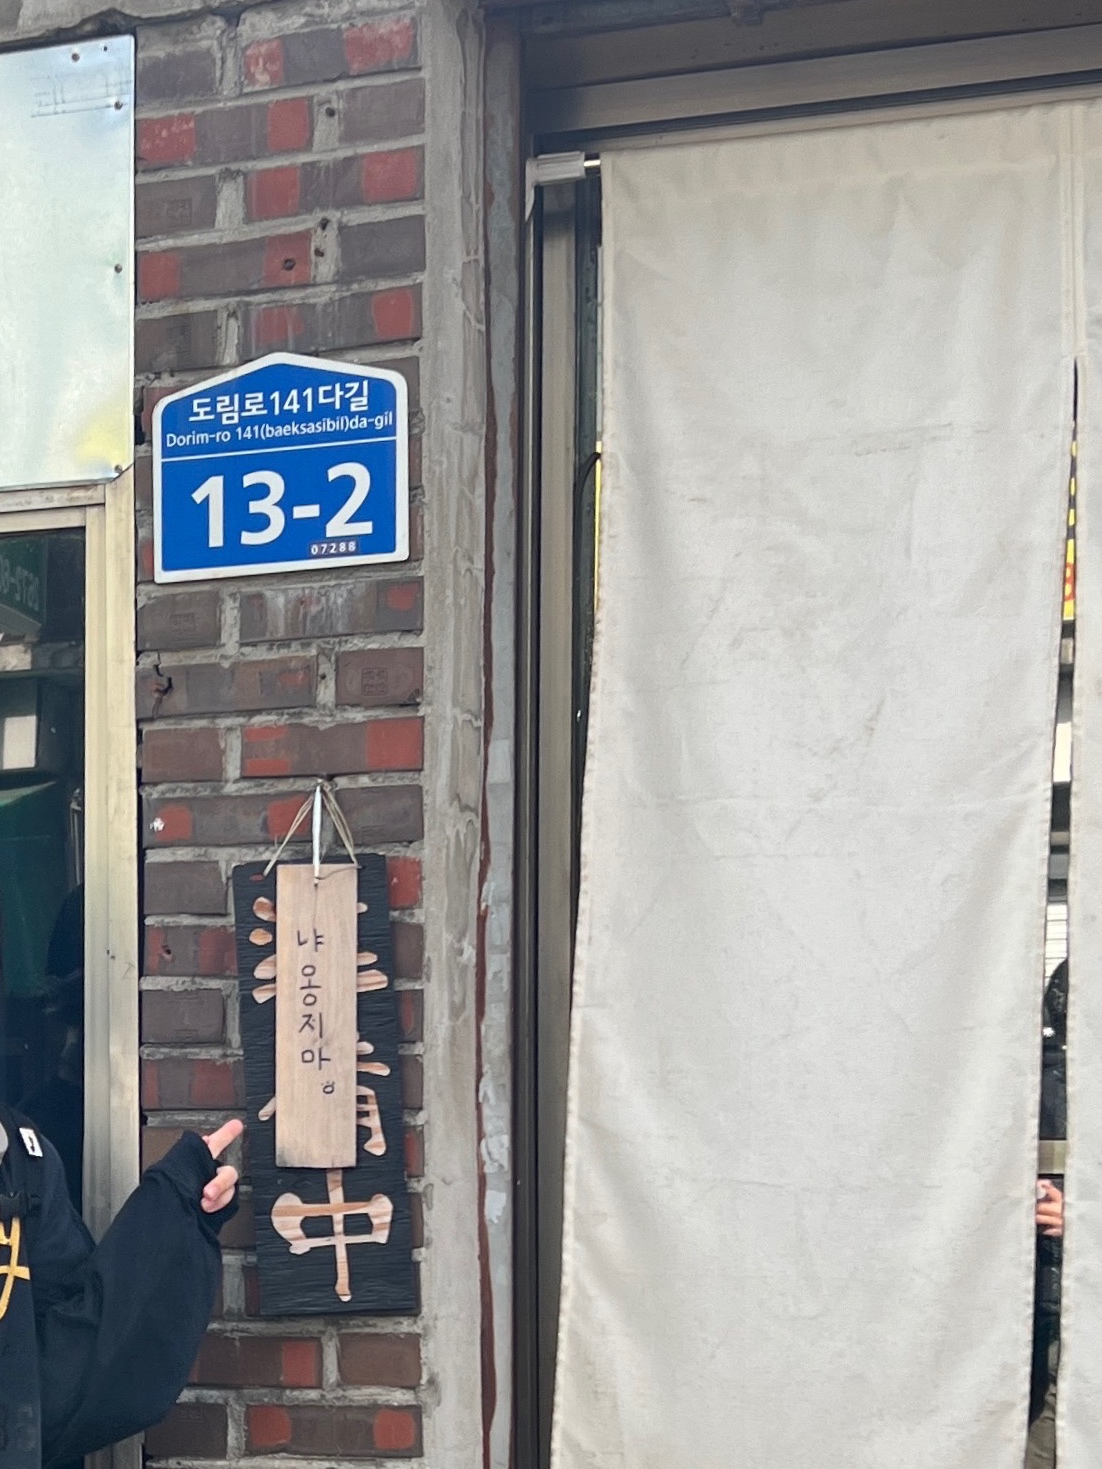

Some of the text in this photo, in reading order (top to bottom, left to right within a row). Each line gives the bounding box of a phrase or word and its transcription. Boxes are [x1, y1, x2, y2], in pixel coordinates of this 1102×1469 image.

[189, 380, 369, 424] 도림로141다길
[166, 411, 393, 448] Dorim-ro 141(baeksasibil)da-gil
[191, 461, 373, 548] 13-2
[311, 541, 356, 555] 07288
